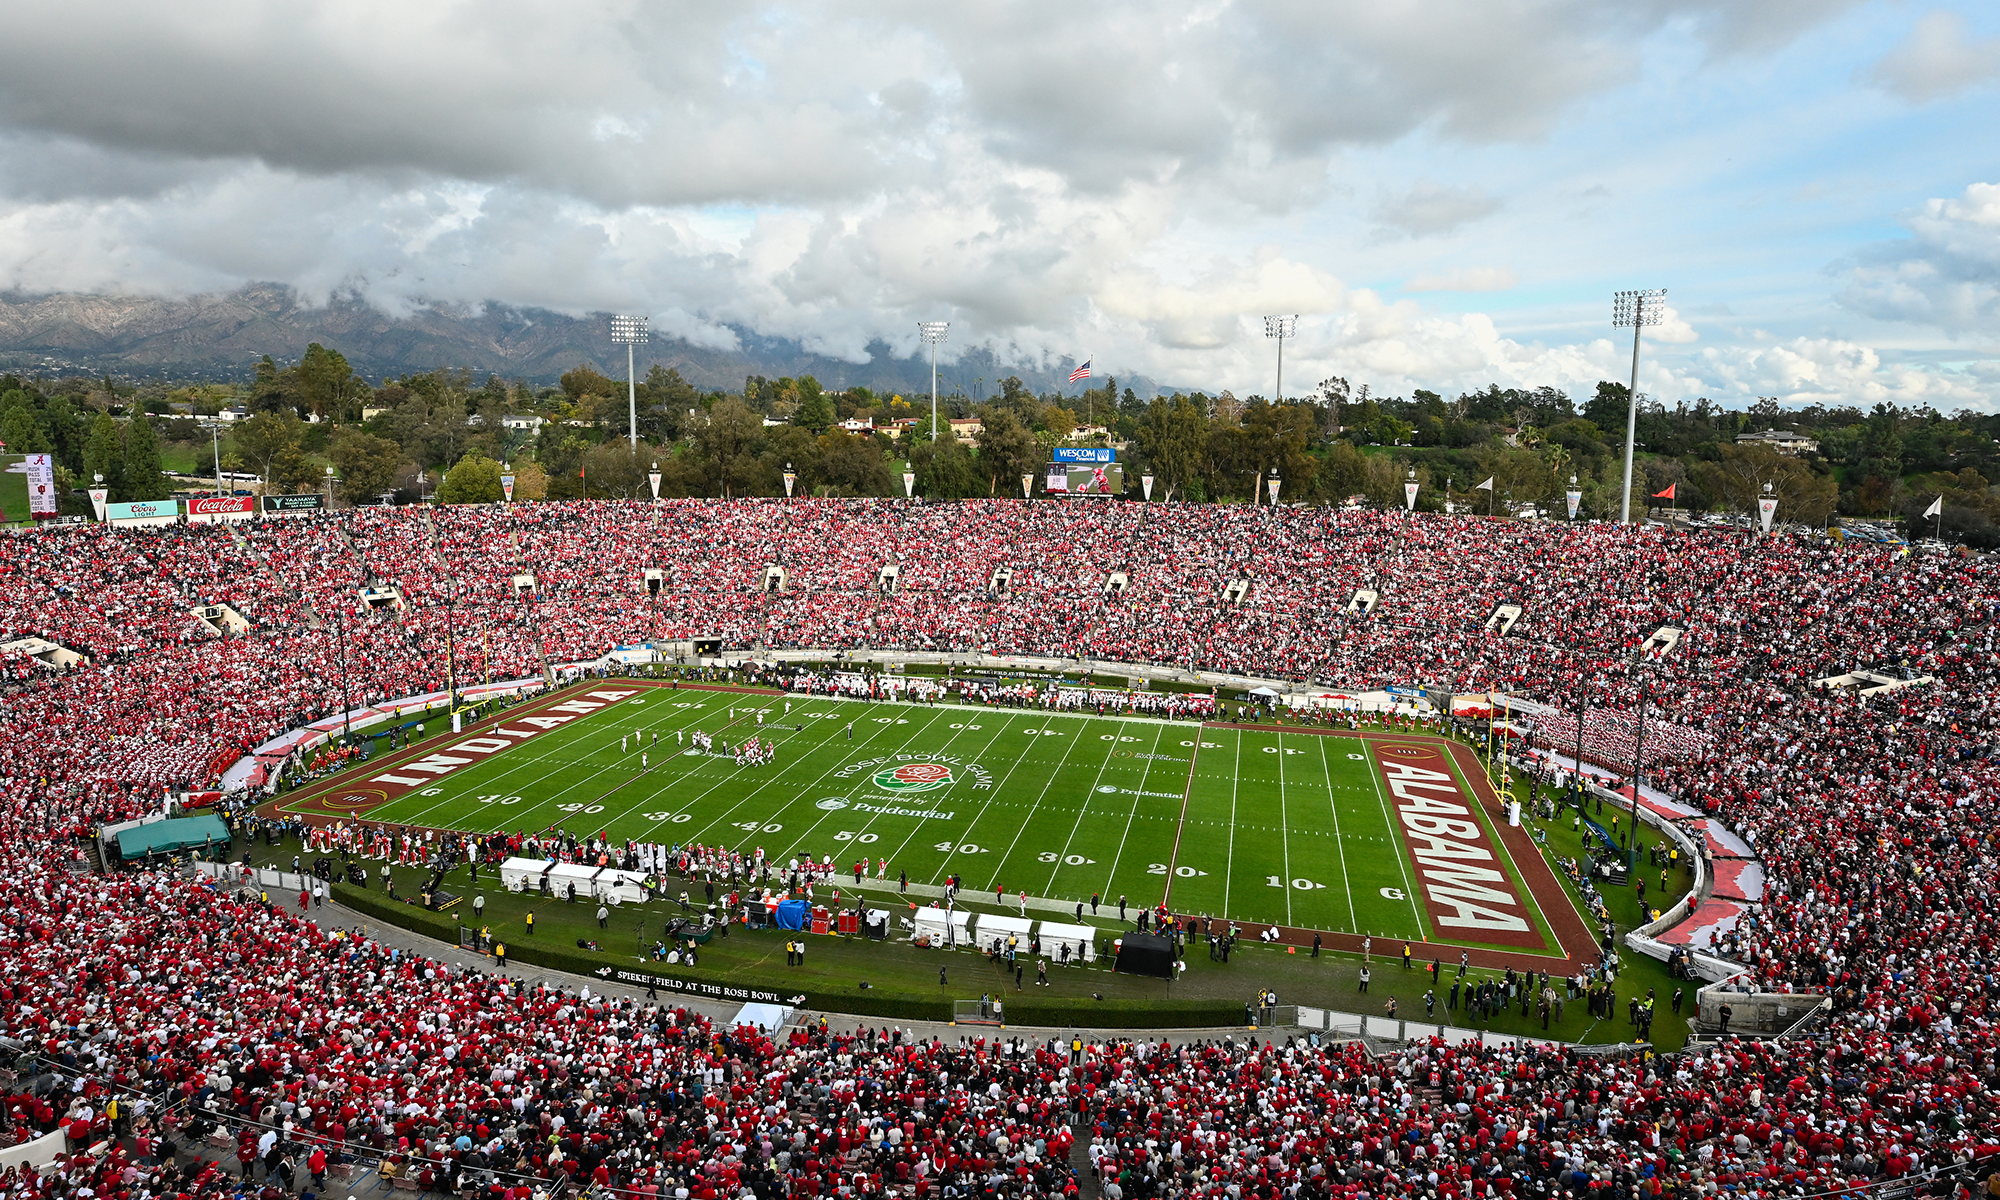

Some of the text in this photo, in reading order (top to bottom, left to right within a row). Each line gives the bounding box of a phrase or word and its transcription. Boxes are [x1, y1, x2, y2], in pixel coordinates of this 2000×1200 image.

[1059, 449, 1095, 457] WESCOM
[130, 504, 157, 513] Coors
[196, 498, 244, 512] Coca-Cola
[369, 689, 639, 787] INDIANA
[833, 754, 993, 791] ROSE BOWL GAME
[420, 788, 444, 797] G
[479, 794, 522, 805] 10
[859, 794, 912, 802] presented
[1119, 788, 1183, 799] Prudential
[561, 802, 605, 814] 20
[851, 803, 955, 820] Prudential
[648, 811, 692, 824] 30
[740, 821, 783, 834] 40
[833, 830, 879, 844] 50
[933, 841, 979, 855] 40
[1382, 760, 1530, 932] ALABAMA
[1037, 851, 1086, 866] 30
[1146, 863, 1197, 878] 20
[1265, 875, 1314, 890] 10
[1379, 886, 1406, 901] G
[656, 977, 683, 989] FIELD
[685, 982, 698, 991] AT
[701, 983, 721, 995] THE
[723, 987, 748, 999] ROSE
[751, 990, 780, 1002] BOWL
